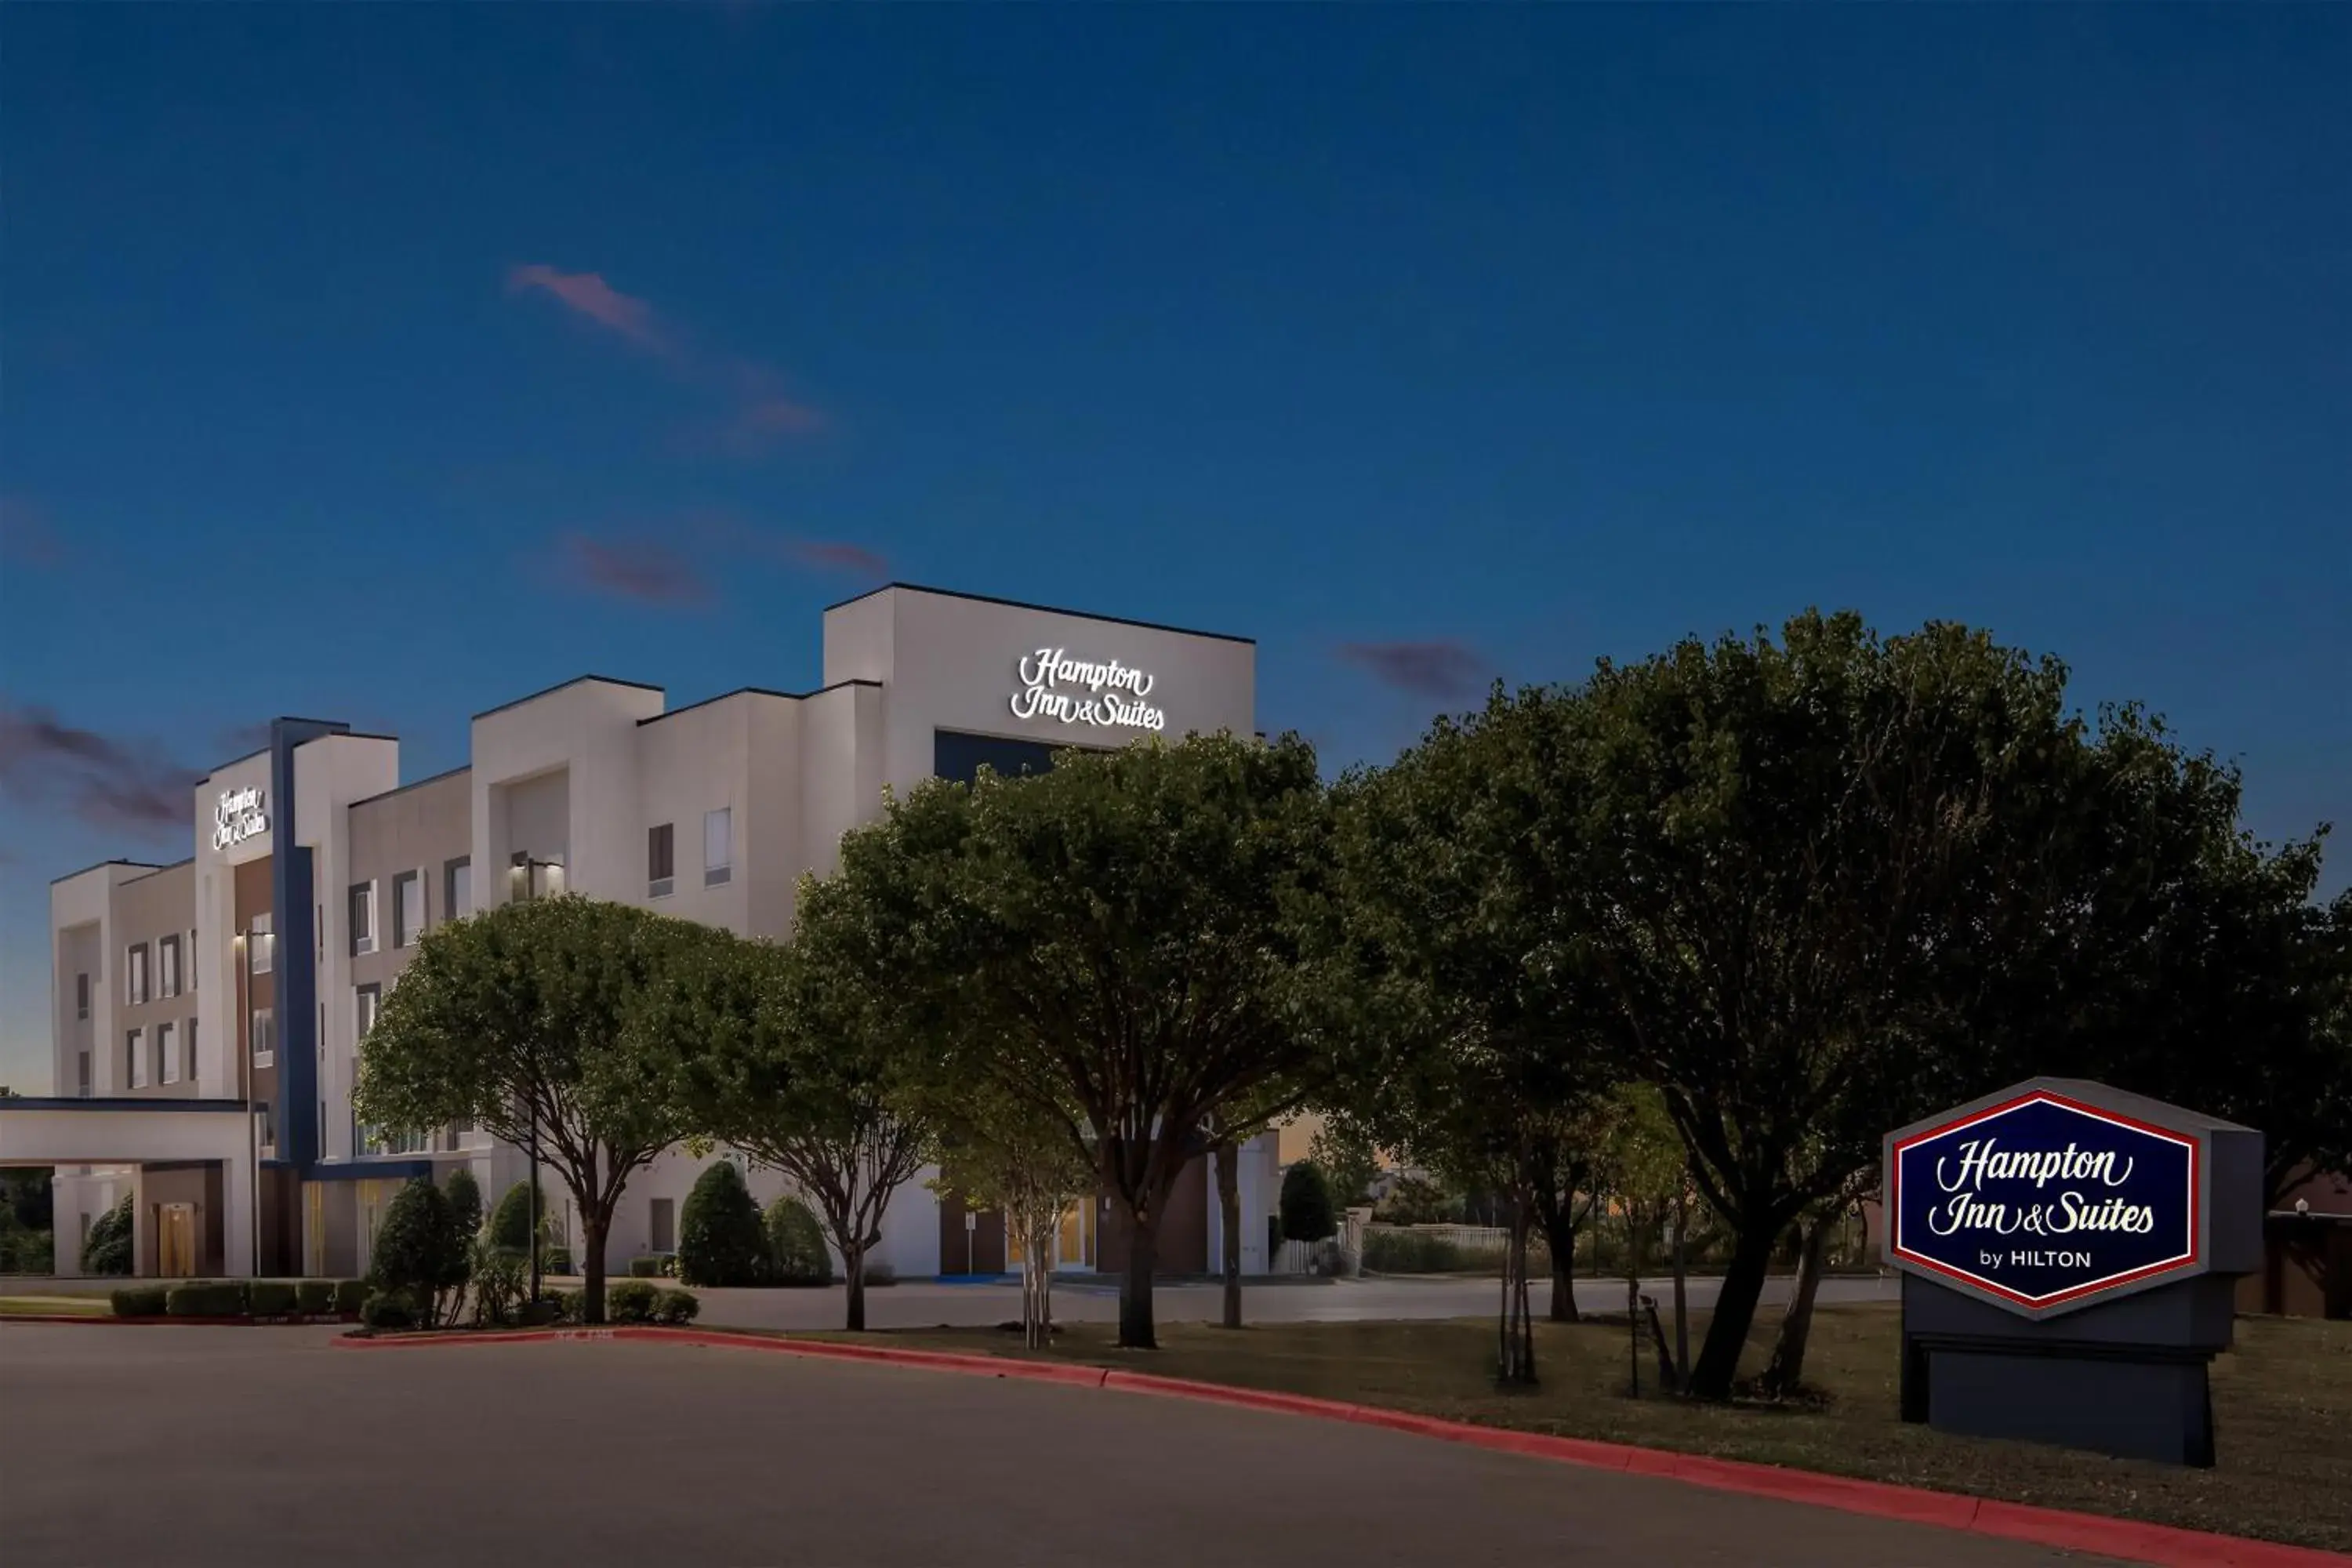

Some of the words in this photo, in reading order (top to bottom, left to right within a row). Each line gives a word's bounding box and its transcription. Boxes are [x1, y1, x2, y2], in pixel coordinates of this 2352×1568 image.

[1019, 648, 1153, 696] Hampton
[1011, 684, 1080, 723] Inn
[1080, 700, 1098, 725] &
[1094, 693, 1164, 730] Suites
[1936, 1138, 2133, 1192] Hampton
[1929, 1192, 2022, 1235] Inn
[2024, 1203, 2048, 1236] &
[2045, 1191, 2154, 1234] Suites
[1980, 1249, 2002, 1269] by
[2011, 1250, 2091, 1268] HILTON
